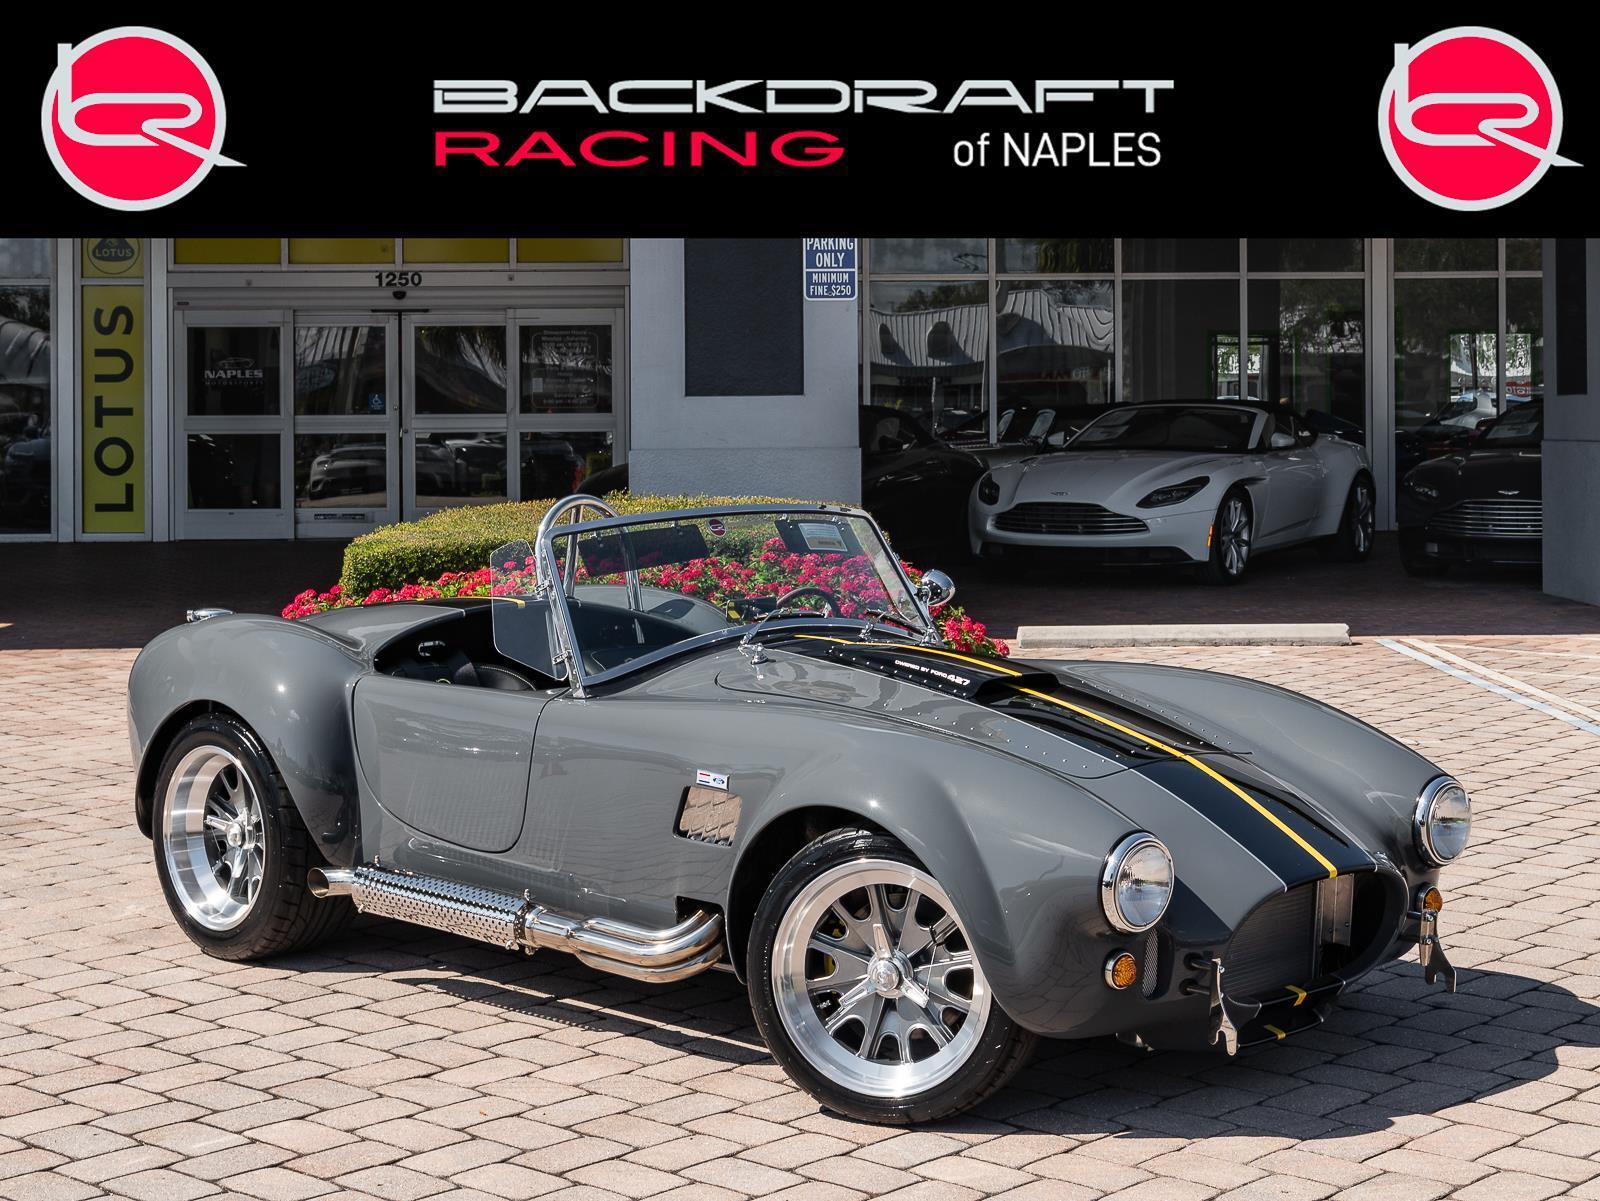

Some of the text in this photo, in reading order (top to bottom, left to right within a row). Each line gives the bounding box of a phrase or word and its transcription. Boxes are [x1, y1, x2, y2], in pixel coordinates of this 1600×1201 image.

[806, 238, 854, 250] PARKING
[95, 248, 132, 257] LOTUS
[815, 252, 845, 267] ONLY
[375, 271, 422, 287] 1250
[812, 272, 849, 283] MINIMUM
[810, 284, 851, 296] FINE $250
[204, 369, 263, 379] NAPLES
[93, 304, 134, 513] LOTUS
[930, 668, 947, 679] FORD
[947, 674, 970, 685] 427
